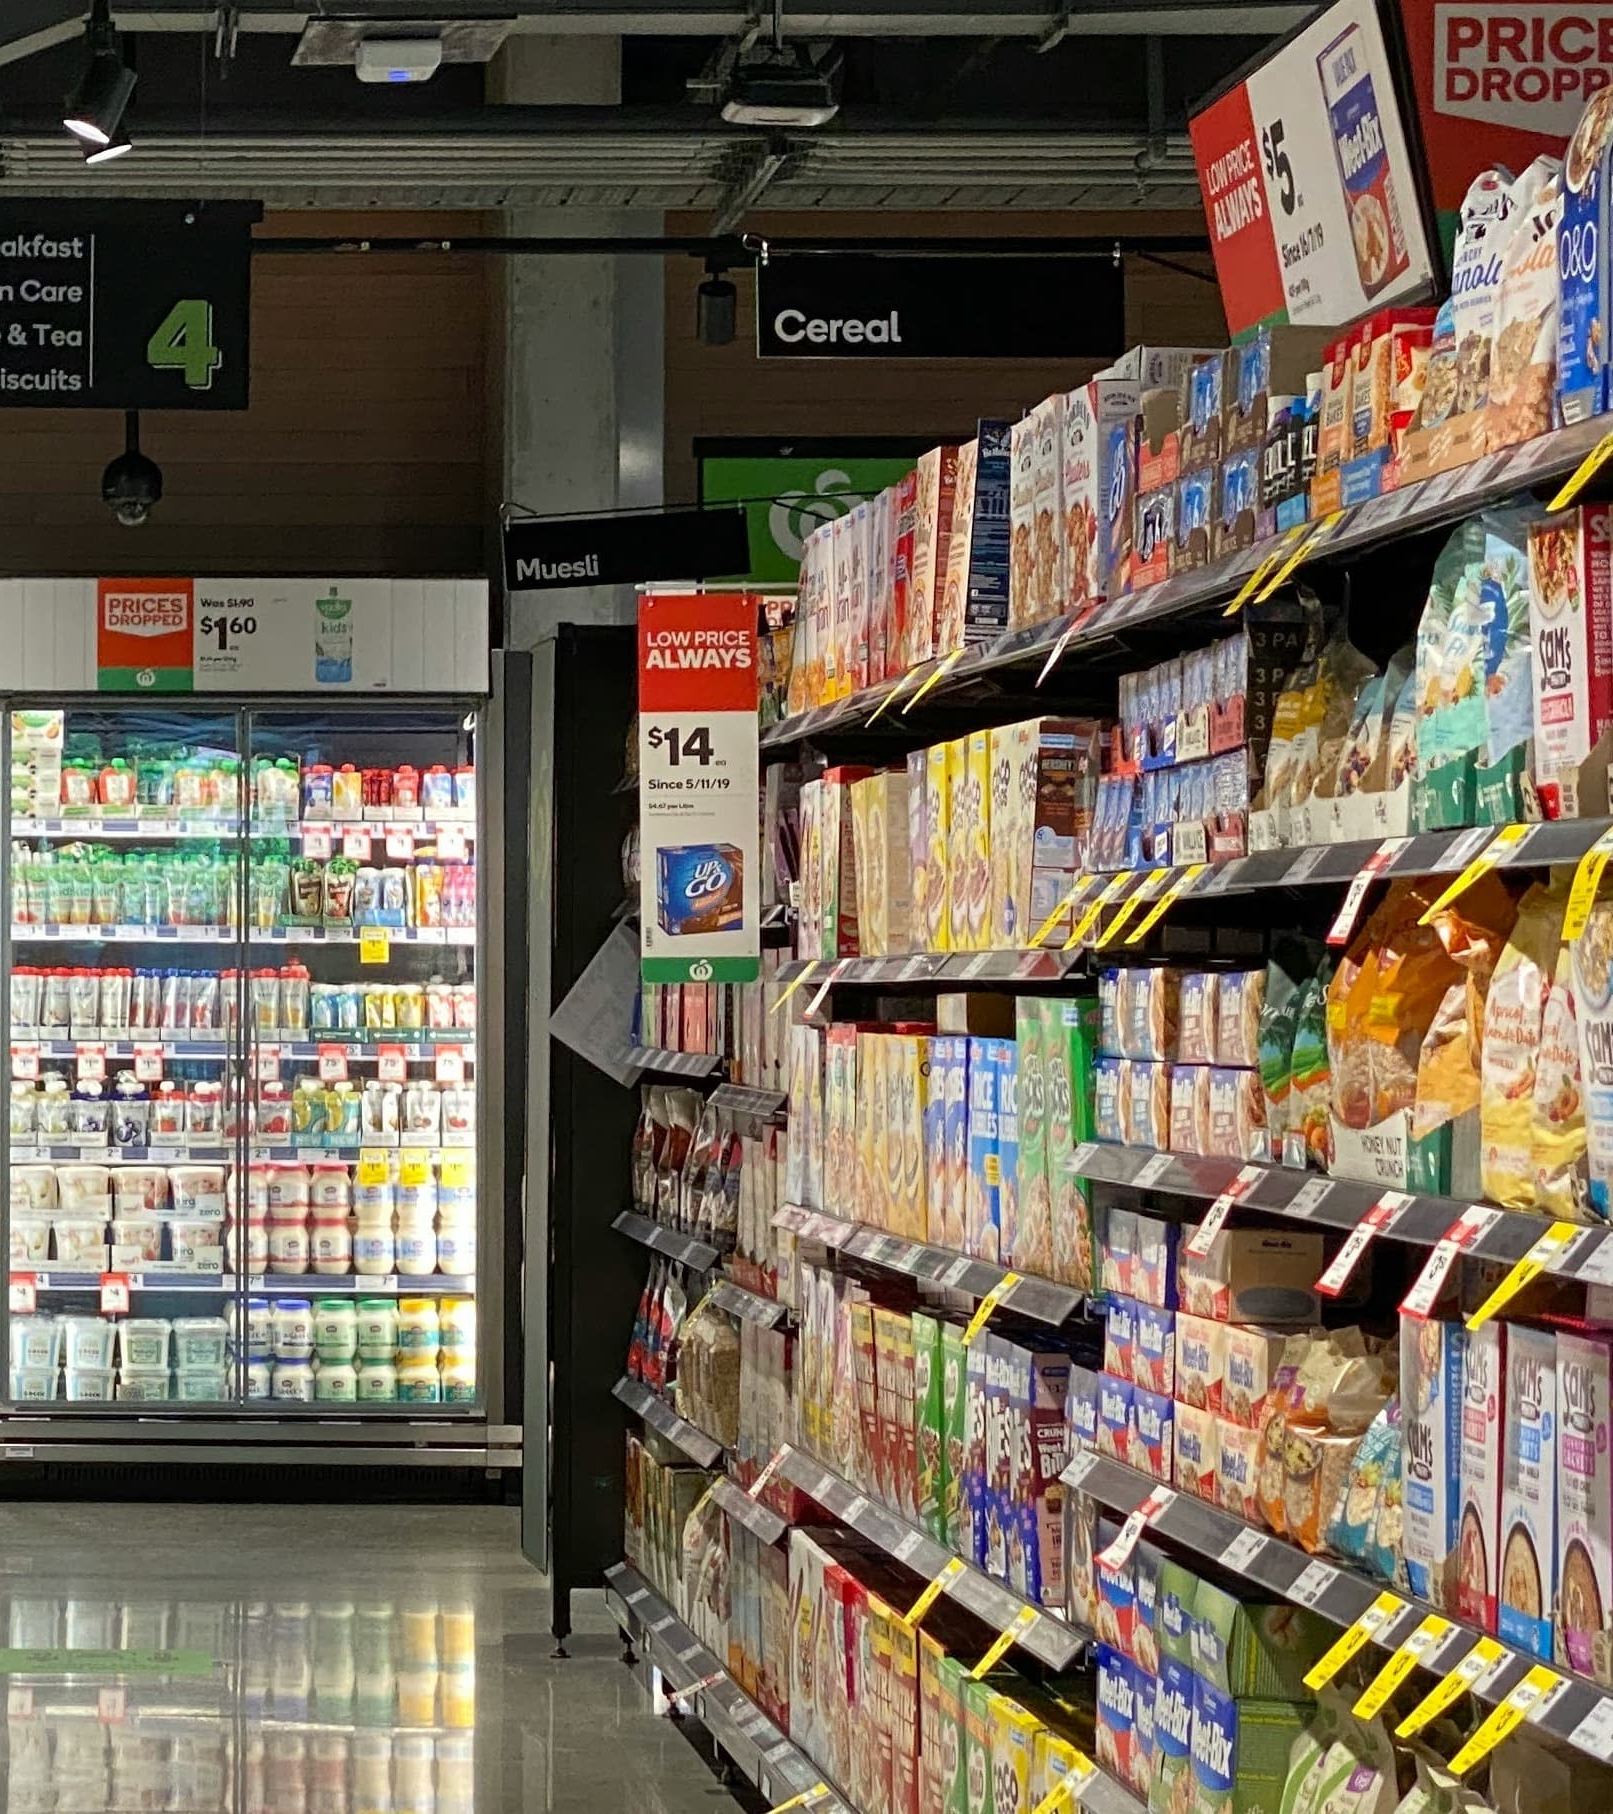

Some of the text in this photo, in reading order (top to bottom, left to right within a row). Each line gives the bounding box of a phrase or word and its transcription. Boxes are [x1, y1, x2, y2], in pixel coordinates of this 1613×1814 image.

[1339, 112, 1383, 178] Weet-Bix
[1205, 138, 1254, 195] LOW PRICE
[1262, 118, 1295, 217] $5
[1214, 177, 1263, 241] ALWAYS
[1282, 235, 1301, 269] Since
[20, 278, 83, 302] Care
[7, 323, 28, 346] &
[32, 324, 83, 347] Tea
[774, 309, 902, 344] Cereal
[147, 299, 223, 390] 4
[516, 553, 600, 583] Muesli
[108, 598, 184, 613] PRICES
[200, 598, 225, 608] Was
[108, 614, 184, 627] DROPPED
[321, 620, 347, 635] kids
[646, 631, 750, 647] LOW PRICE
[645, 648, 752, 669] ALWAYS
[648, 726, 715, 766] $14
[648, 779, 730, 791] Since 5/11/19
[685, 872, 727, 899] GO
[199, 1207, 221, 1217] zero
[197, 1260, 219, 1271] zero
